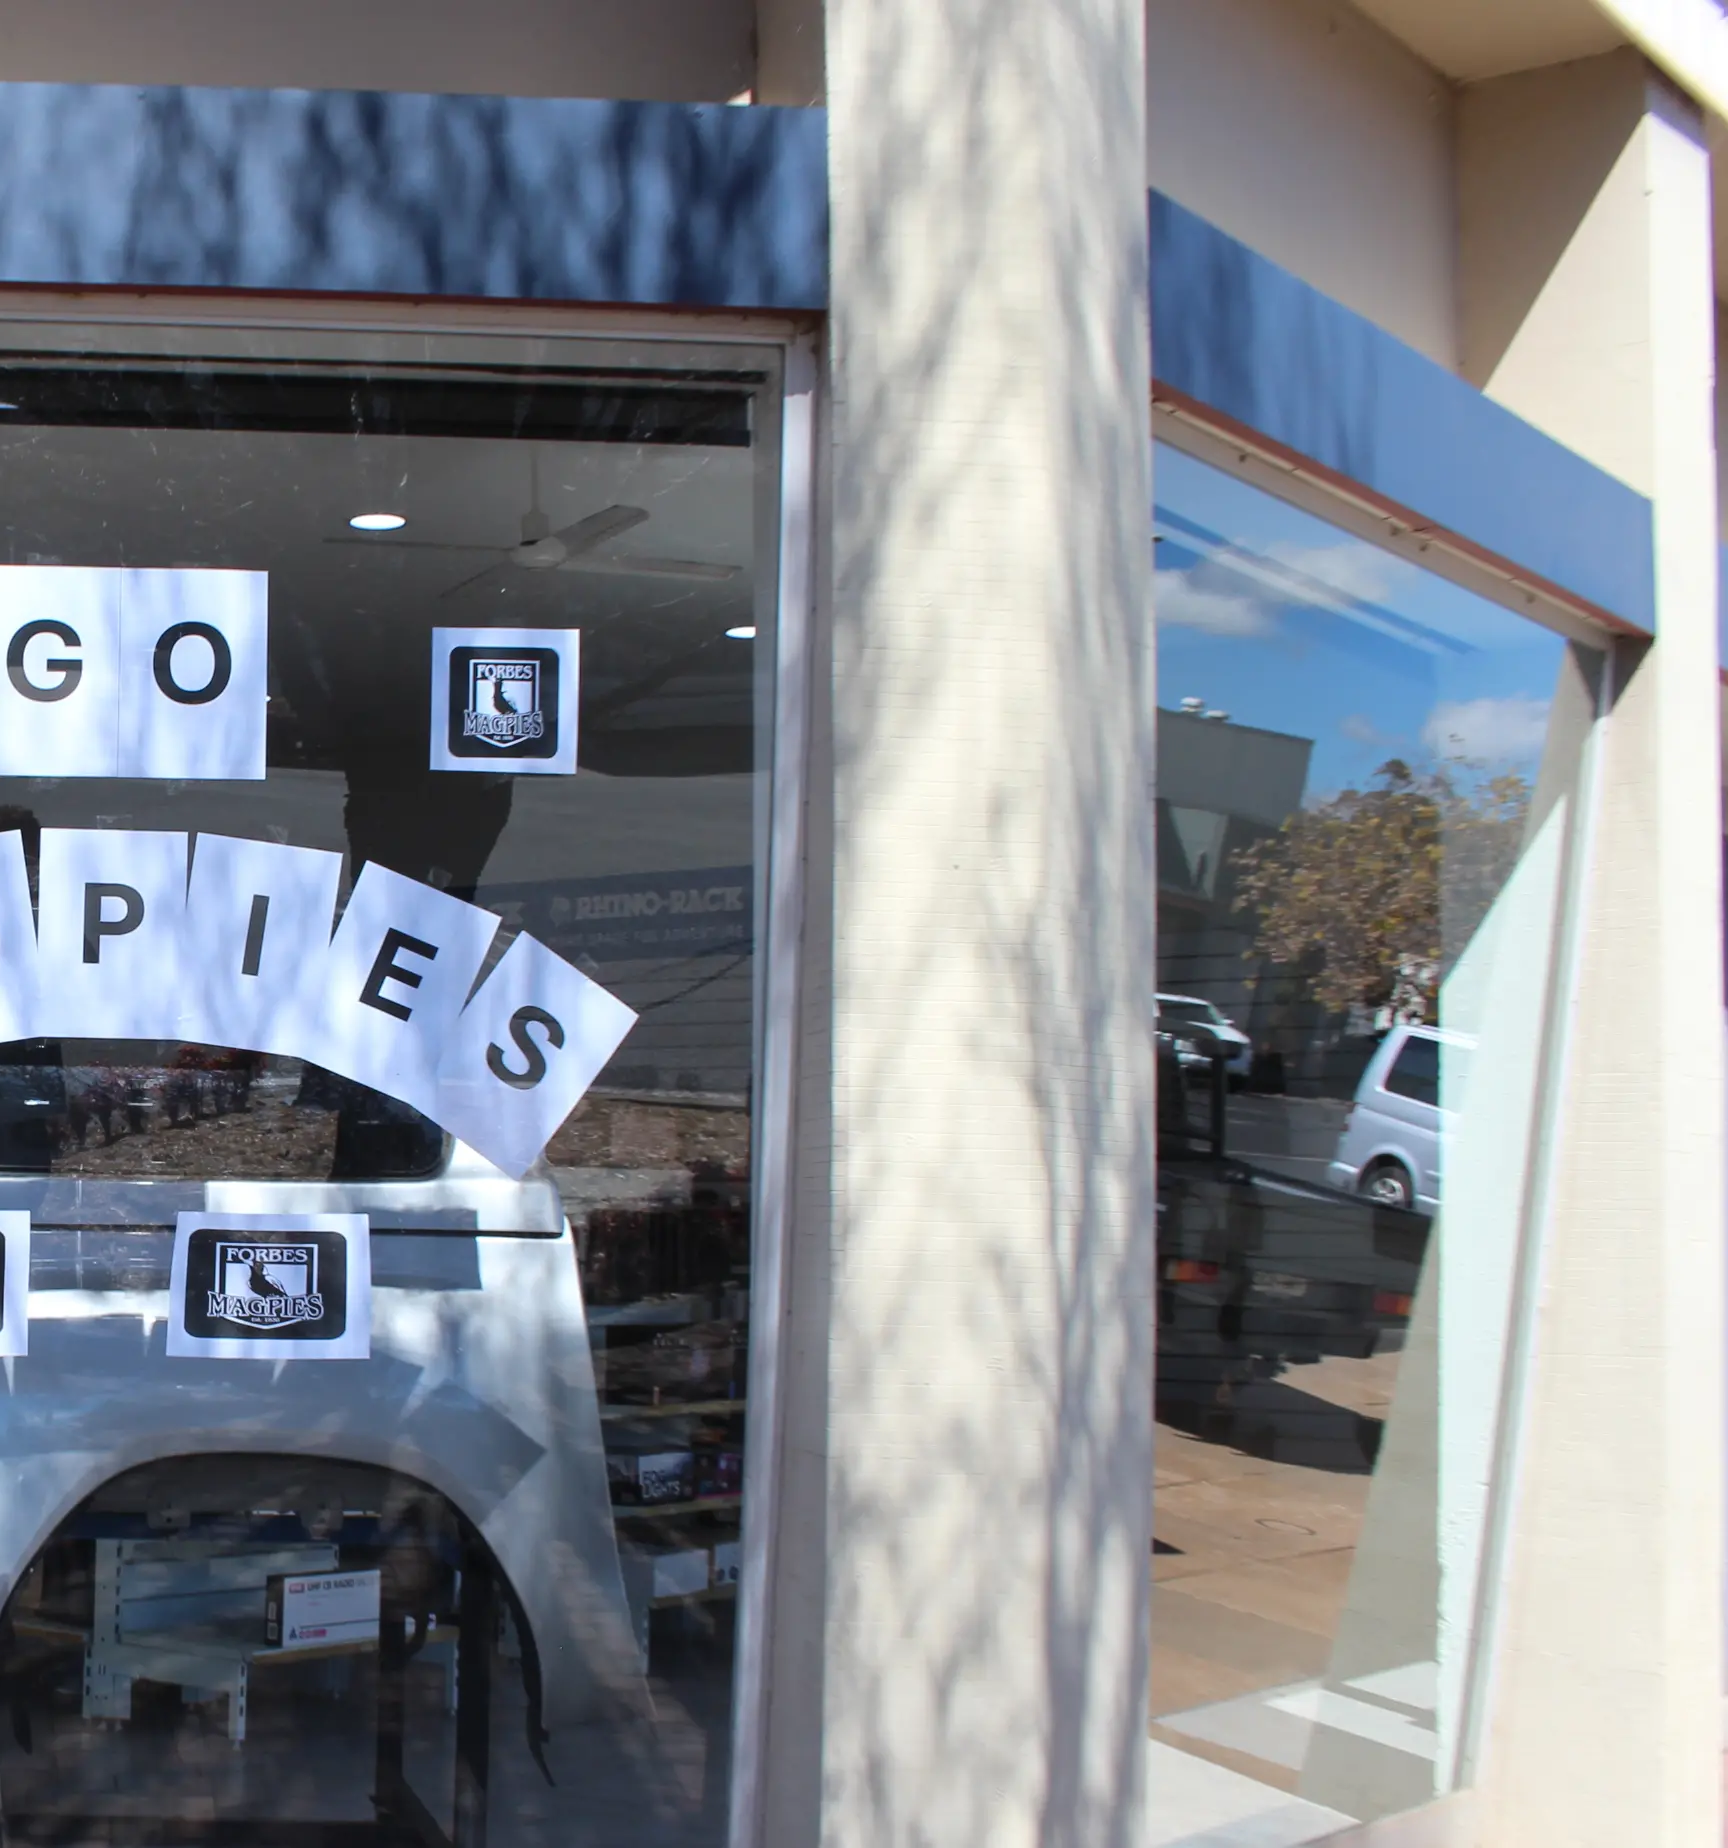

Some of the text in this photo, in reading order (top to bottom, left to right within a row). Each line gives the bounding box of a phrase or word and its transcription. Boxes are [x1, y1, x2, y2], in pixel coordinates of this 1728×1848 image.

[6, 618, 232, 705] GO
[476, 664, 533, 679] FORBES
[463, 709, 543, 738] MAGPIES
[574, 886, 744, 920] RHINO-RACK
[226, 1247, 308, 1263] FORBES
[206, 1290, 324, 1320] MAGPIES
